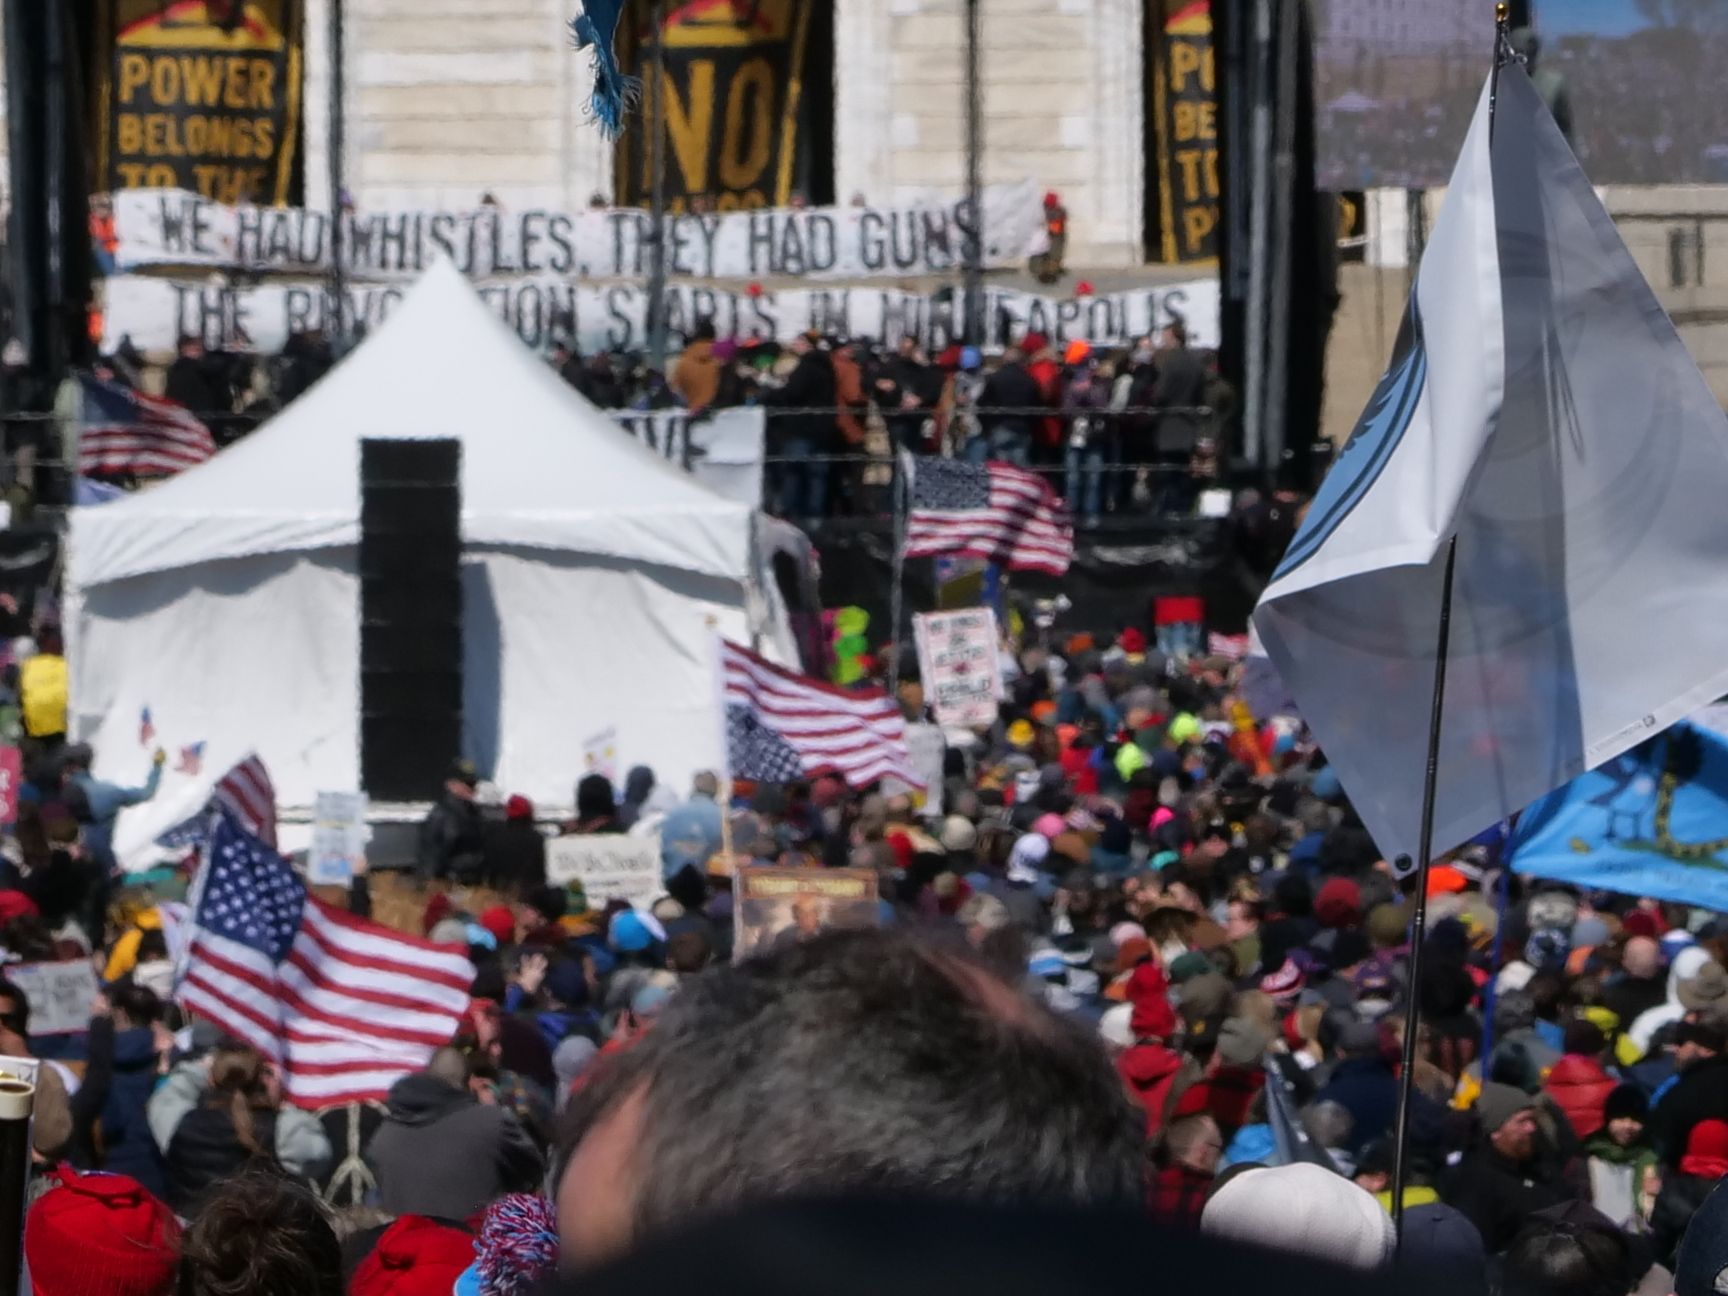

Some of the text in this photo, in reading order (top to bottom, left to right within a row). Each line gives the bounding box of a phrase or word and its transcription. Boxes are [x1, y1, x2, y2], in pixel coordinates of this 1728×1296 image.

[118, 53, 276, 107] POWER
[117, 114, 273, 156] BELONGS
[640, 59, 775, 193] NO
[161, 196, 218, 255] WE
[238, 213, 324, 264] HAD
[609, 213, 721, 277] THEY
[748, 211, 836, 277] HAD
[174, 284, 254, 345] THE
[609, 285, 776, 348] SARTS
[881, 289, 1200, 345] MINEAPOLIS.
